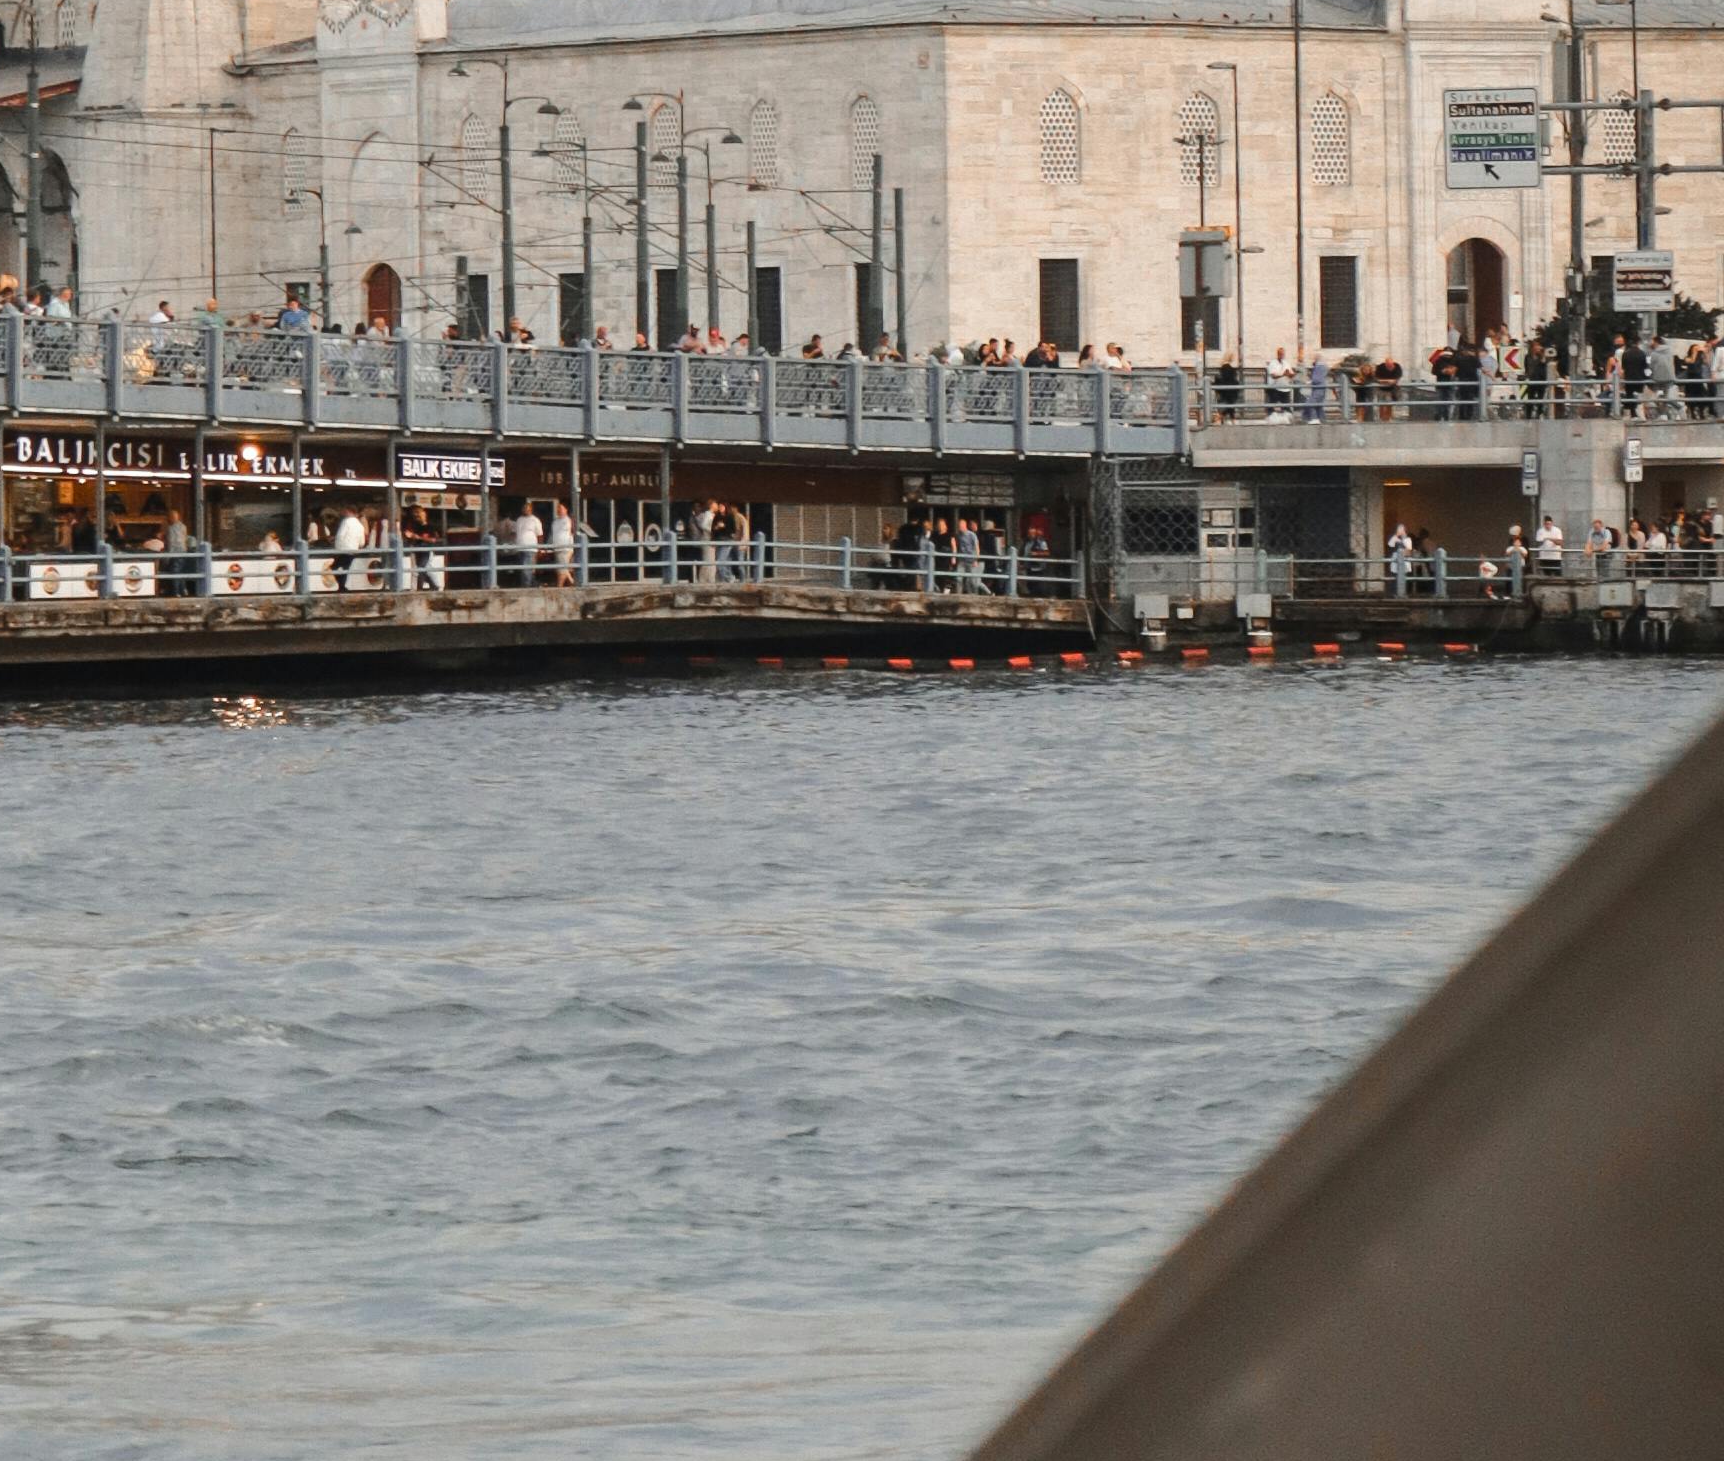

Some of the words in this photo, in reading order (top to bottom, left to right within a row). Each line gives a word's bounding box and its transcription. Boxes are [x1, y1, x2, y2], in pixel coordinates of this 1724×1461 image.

[1451, 93, 1507, 103] Sirkeci
[1450, 104, 1533, 116] Sultanahmet
[1452, 135, 1496, 146] Avrasya
[402, 458, 440, 478] BALIK
